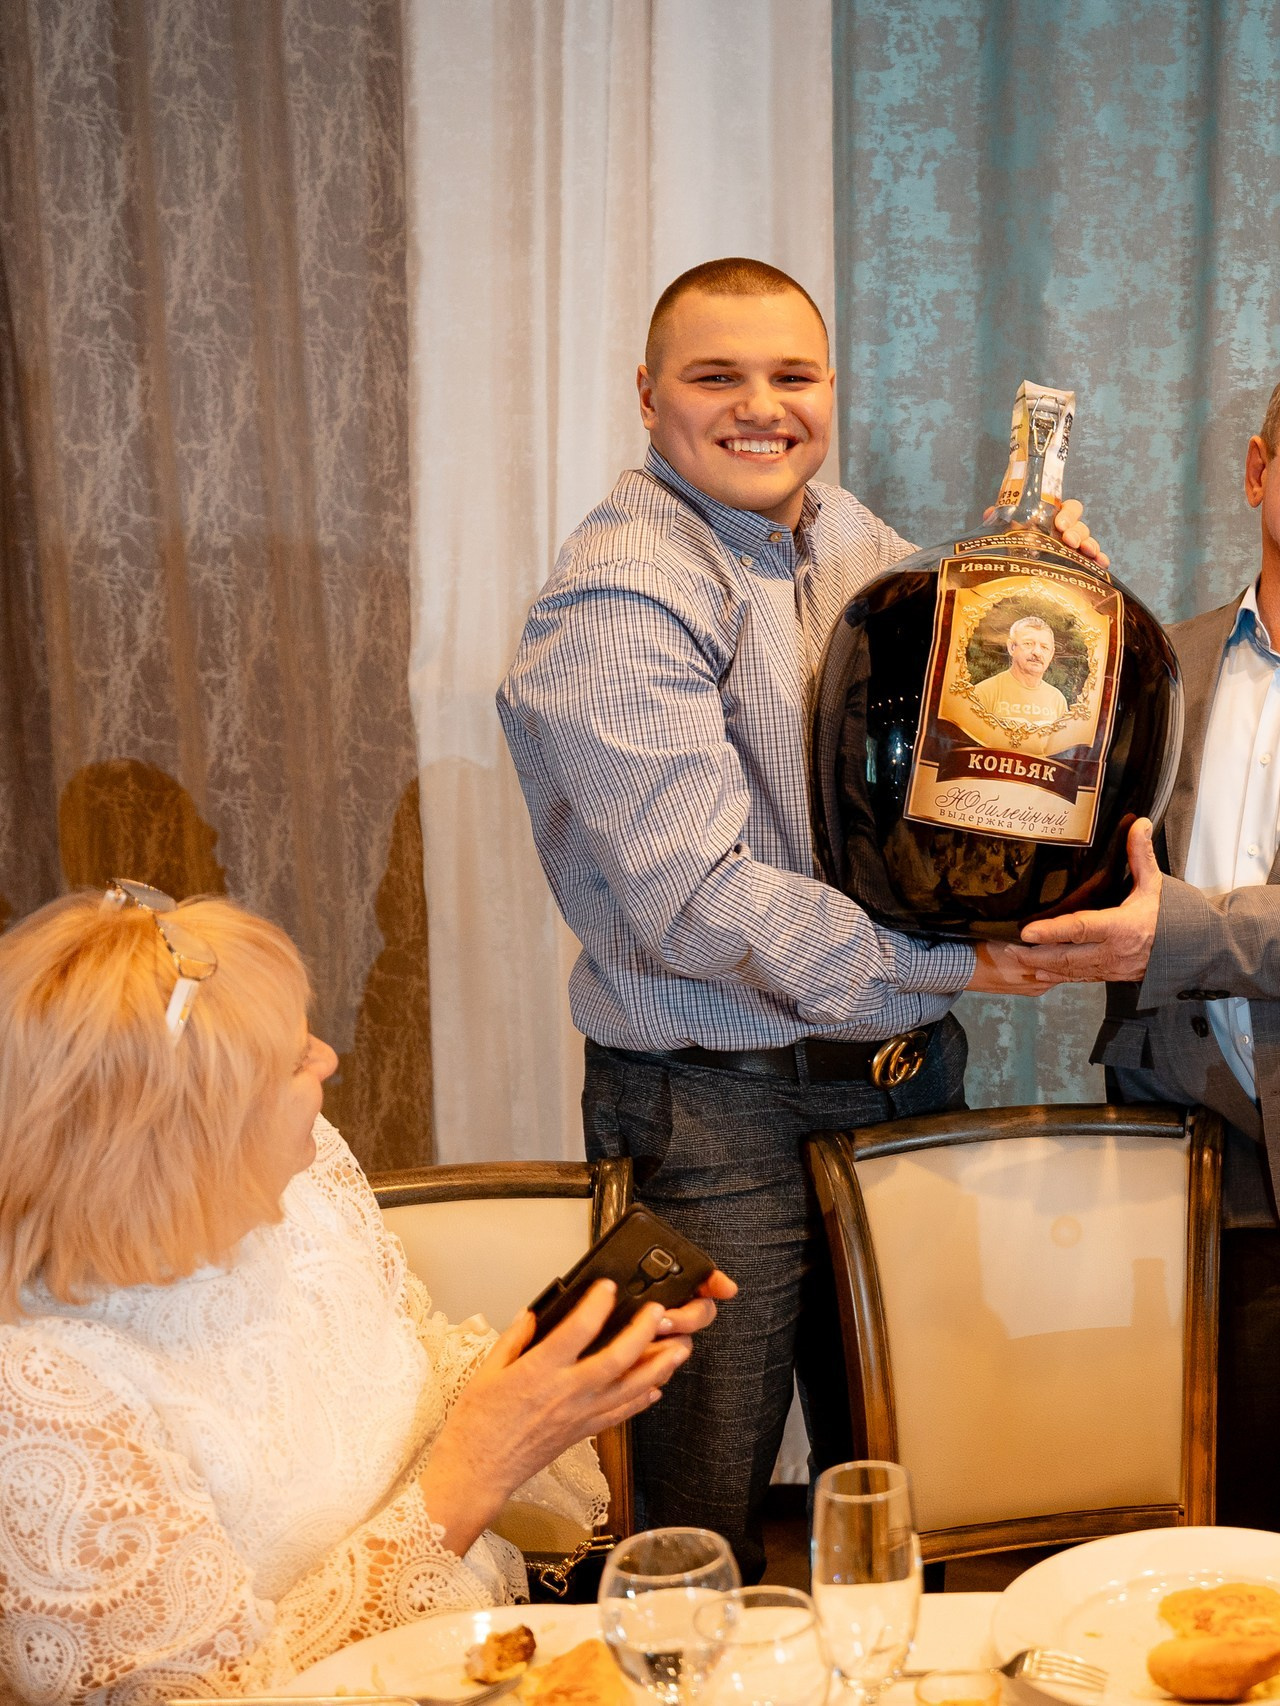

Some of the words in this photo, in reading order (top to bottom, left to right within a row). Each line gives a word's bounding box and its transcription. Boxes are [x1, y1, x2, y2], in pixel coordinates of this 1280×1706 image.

[960, 562, 1005, 573] Иван
[1009, 563, 1107, 597] Васильевич
[968, 753, 1057, 782] КОНЬЯК
[935, 787, 1070, 826] Юбилейный
[940, 808, 1013, 829] выдержка
[1020, 821, 1035, 832] 70
[1041, 826, 1065, 836] лет
